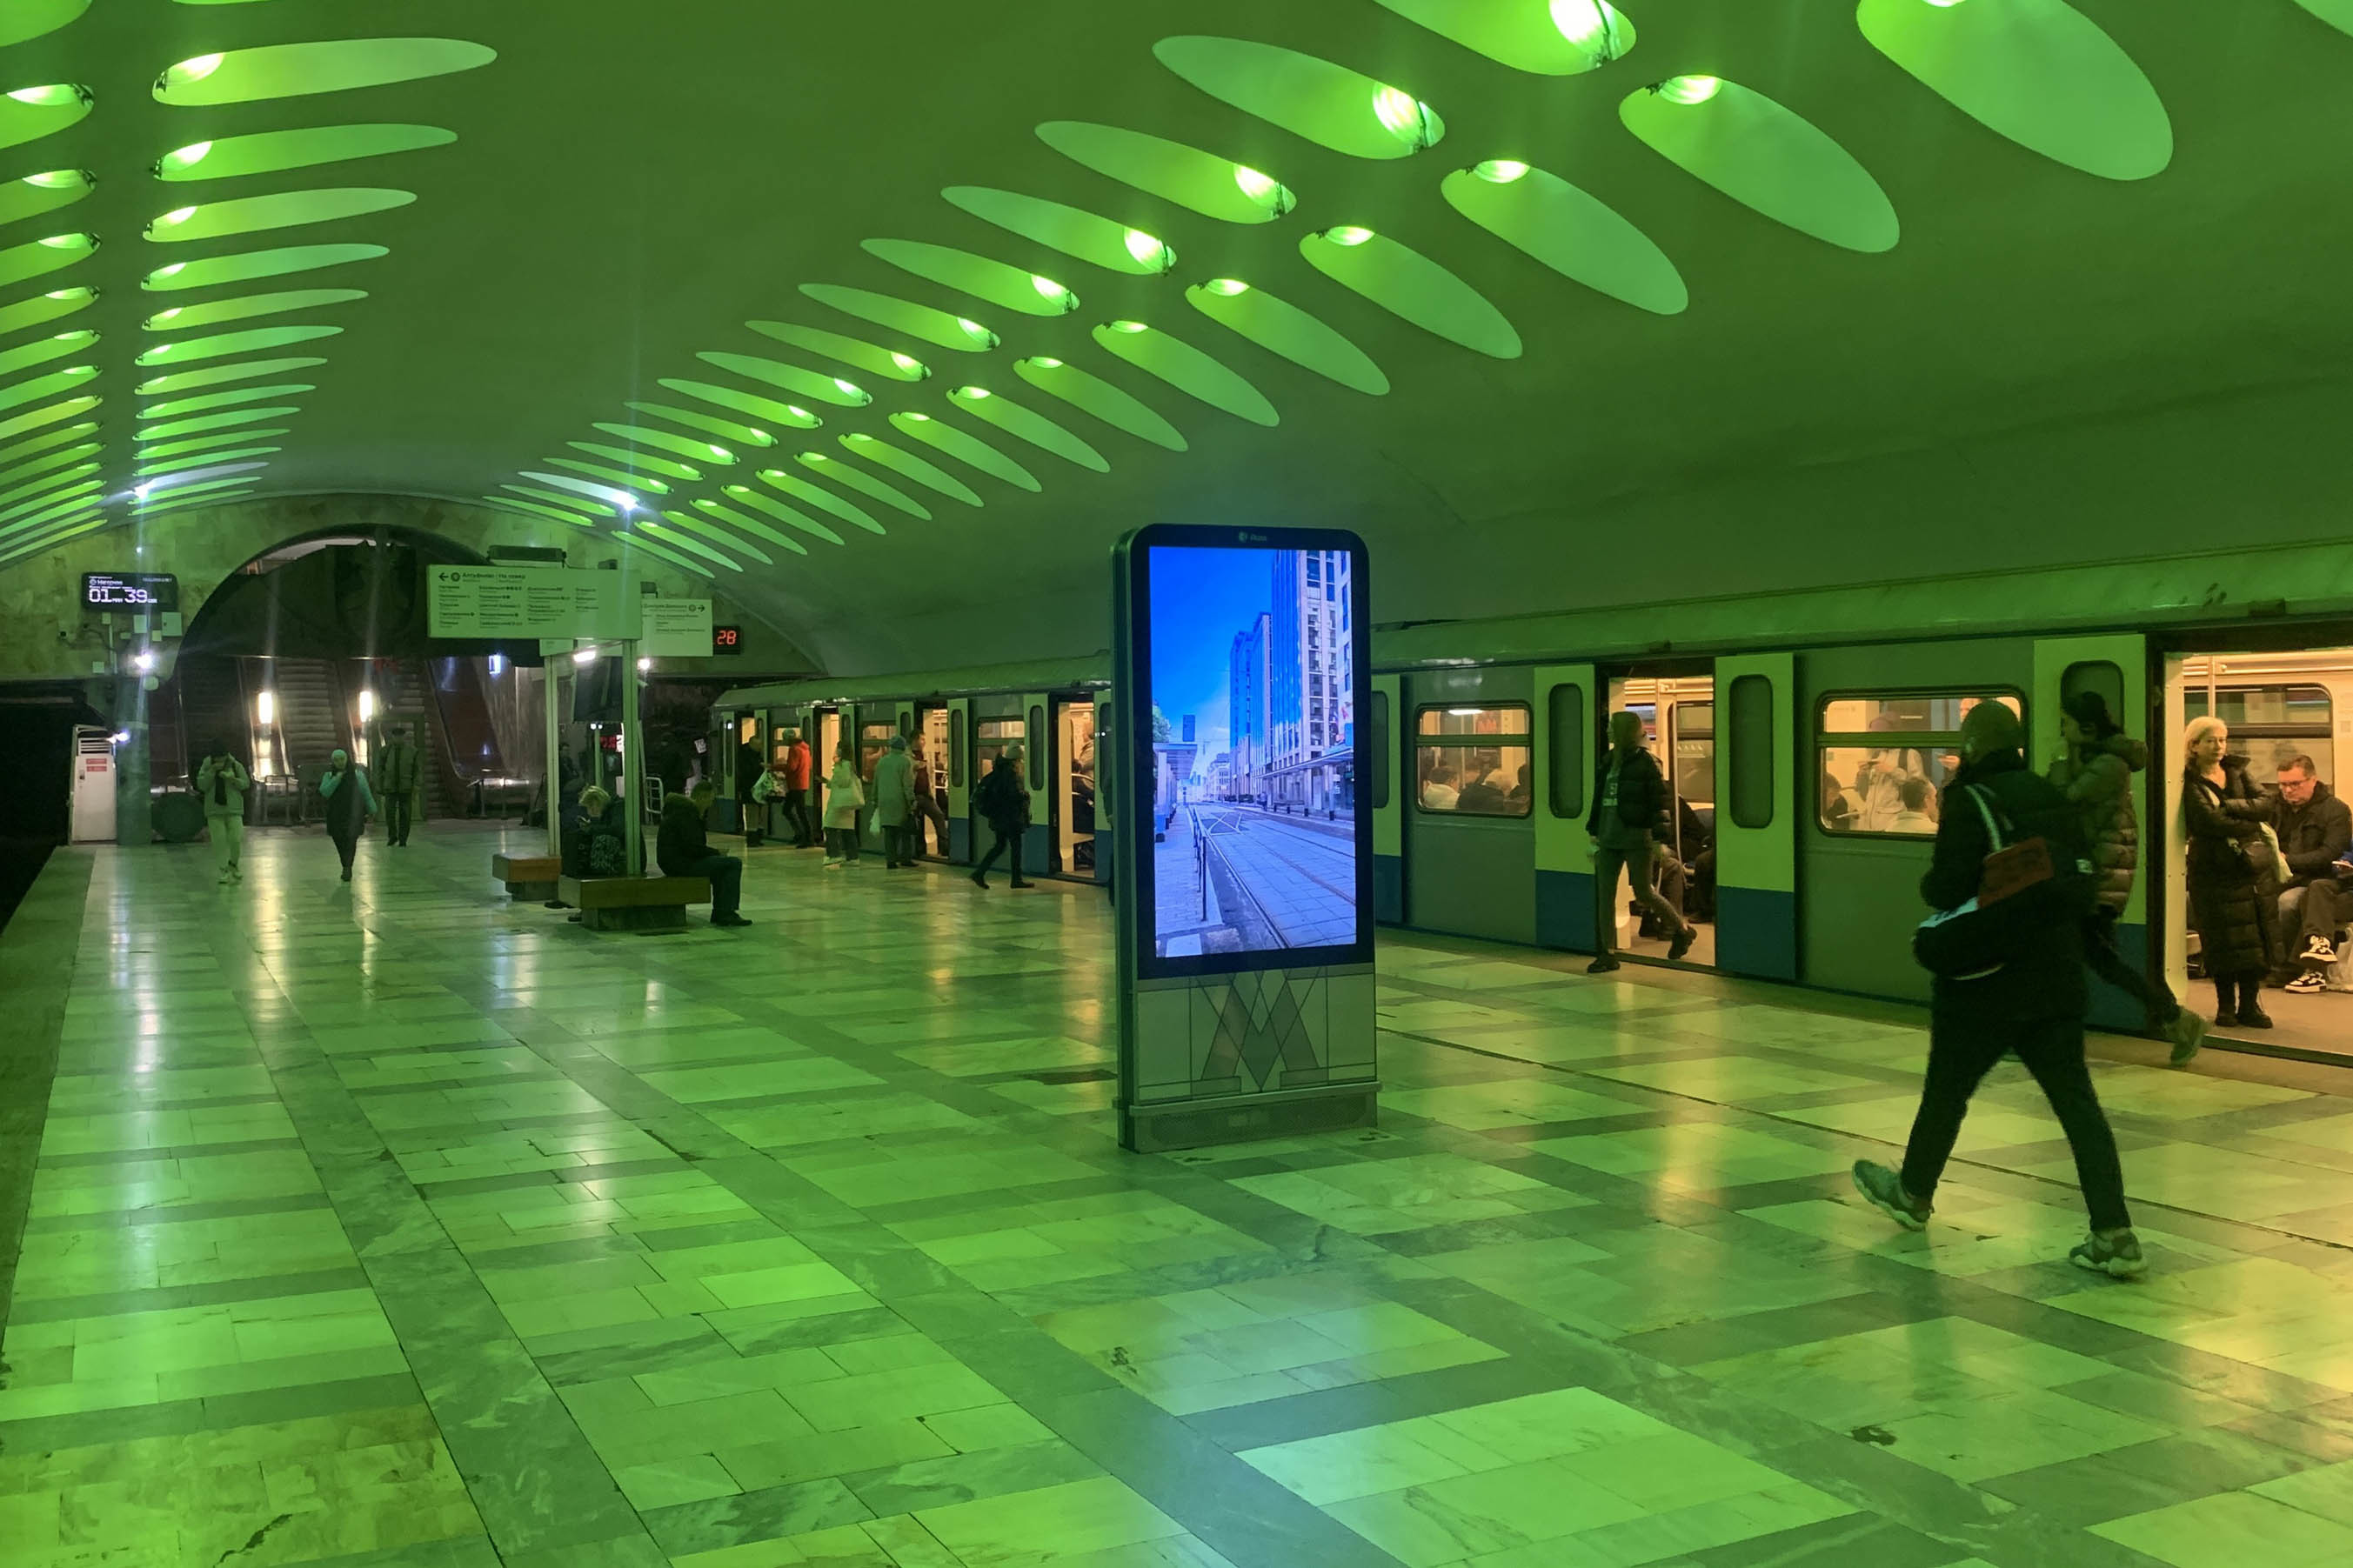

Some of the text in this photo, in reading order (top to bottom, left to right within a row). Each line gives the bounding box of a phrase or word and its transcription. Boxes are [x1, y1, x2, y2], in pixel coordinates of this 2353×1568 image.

[89, 589, 112, 603] 01
[124, 589, 148, 604] 39
[717, 630, 737, 645] 28
